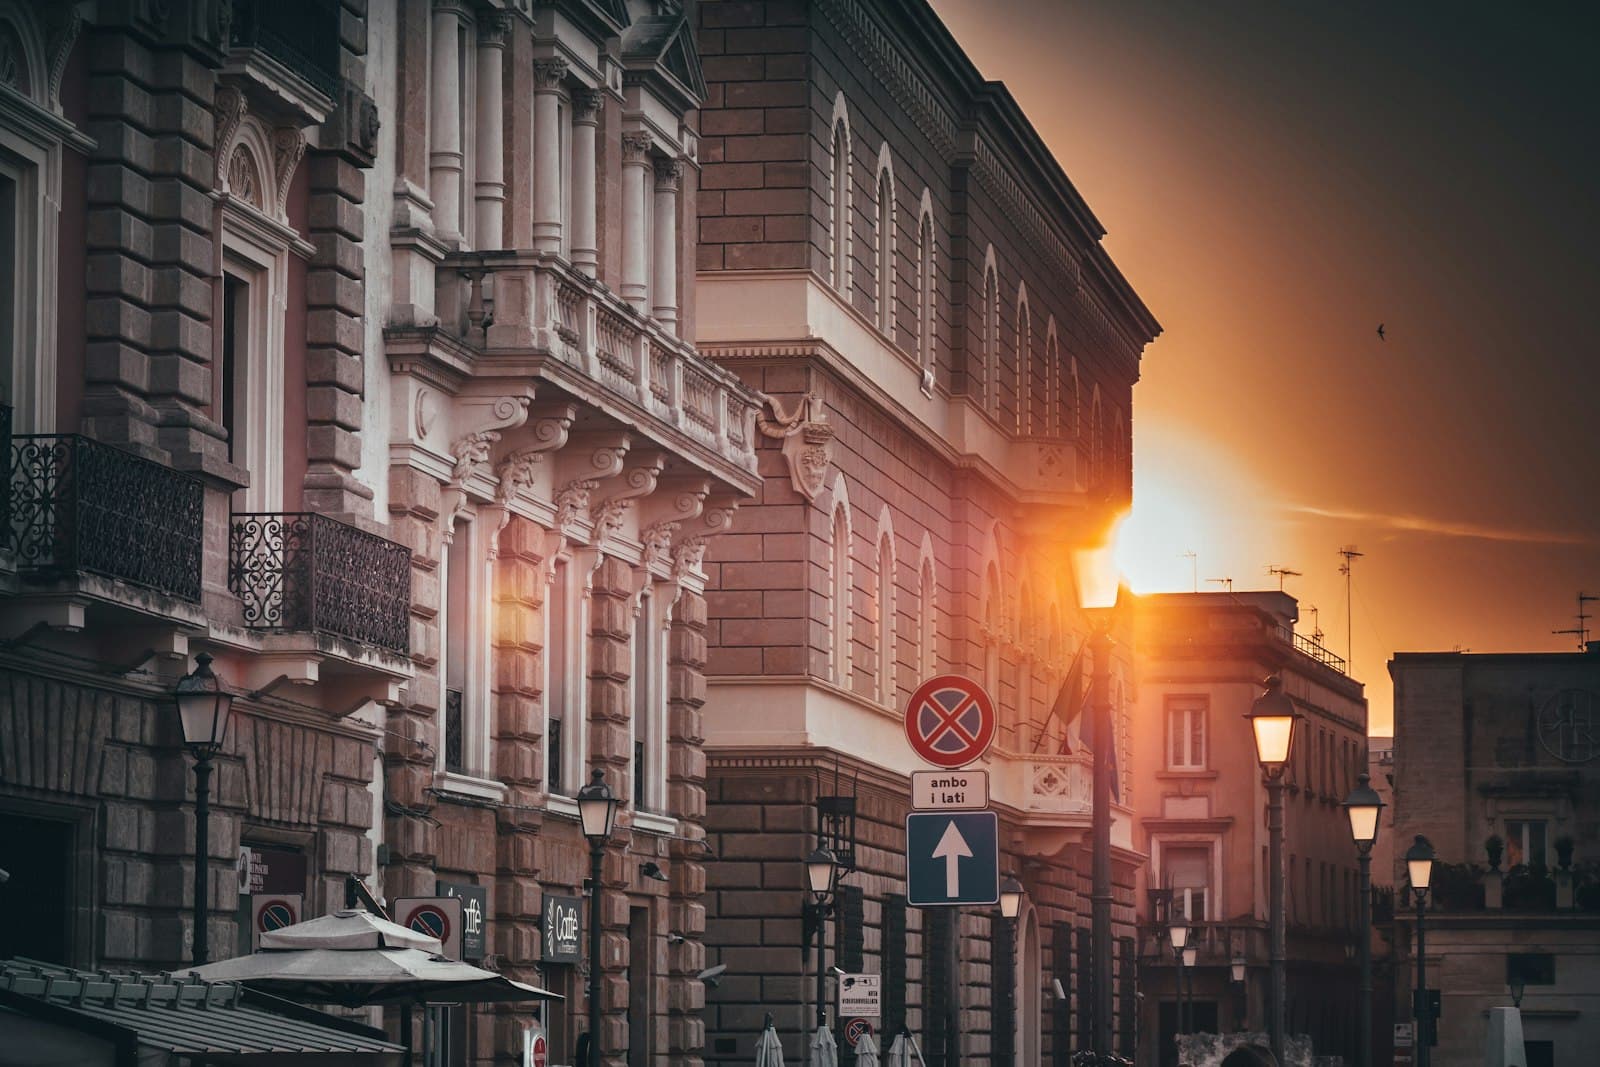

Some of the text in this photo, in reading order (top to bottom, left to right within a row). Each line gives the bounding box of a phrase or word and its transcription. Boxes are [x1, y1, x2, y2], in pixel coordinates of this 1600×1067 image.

[931, 777, 968, 788] ambo
[931, 792, 965, 804] i lati
[556, 905, 578, 941] Caffè
